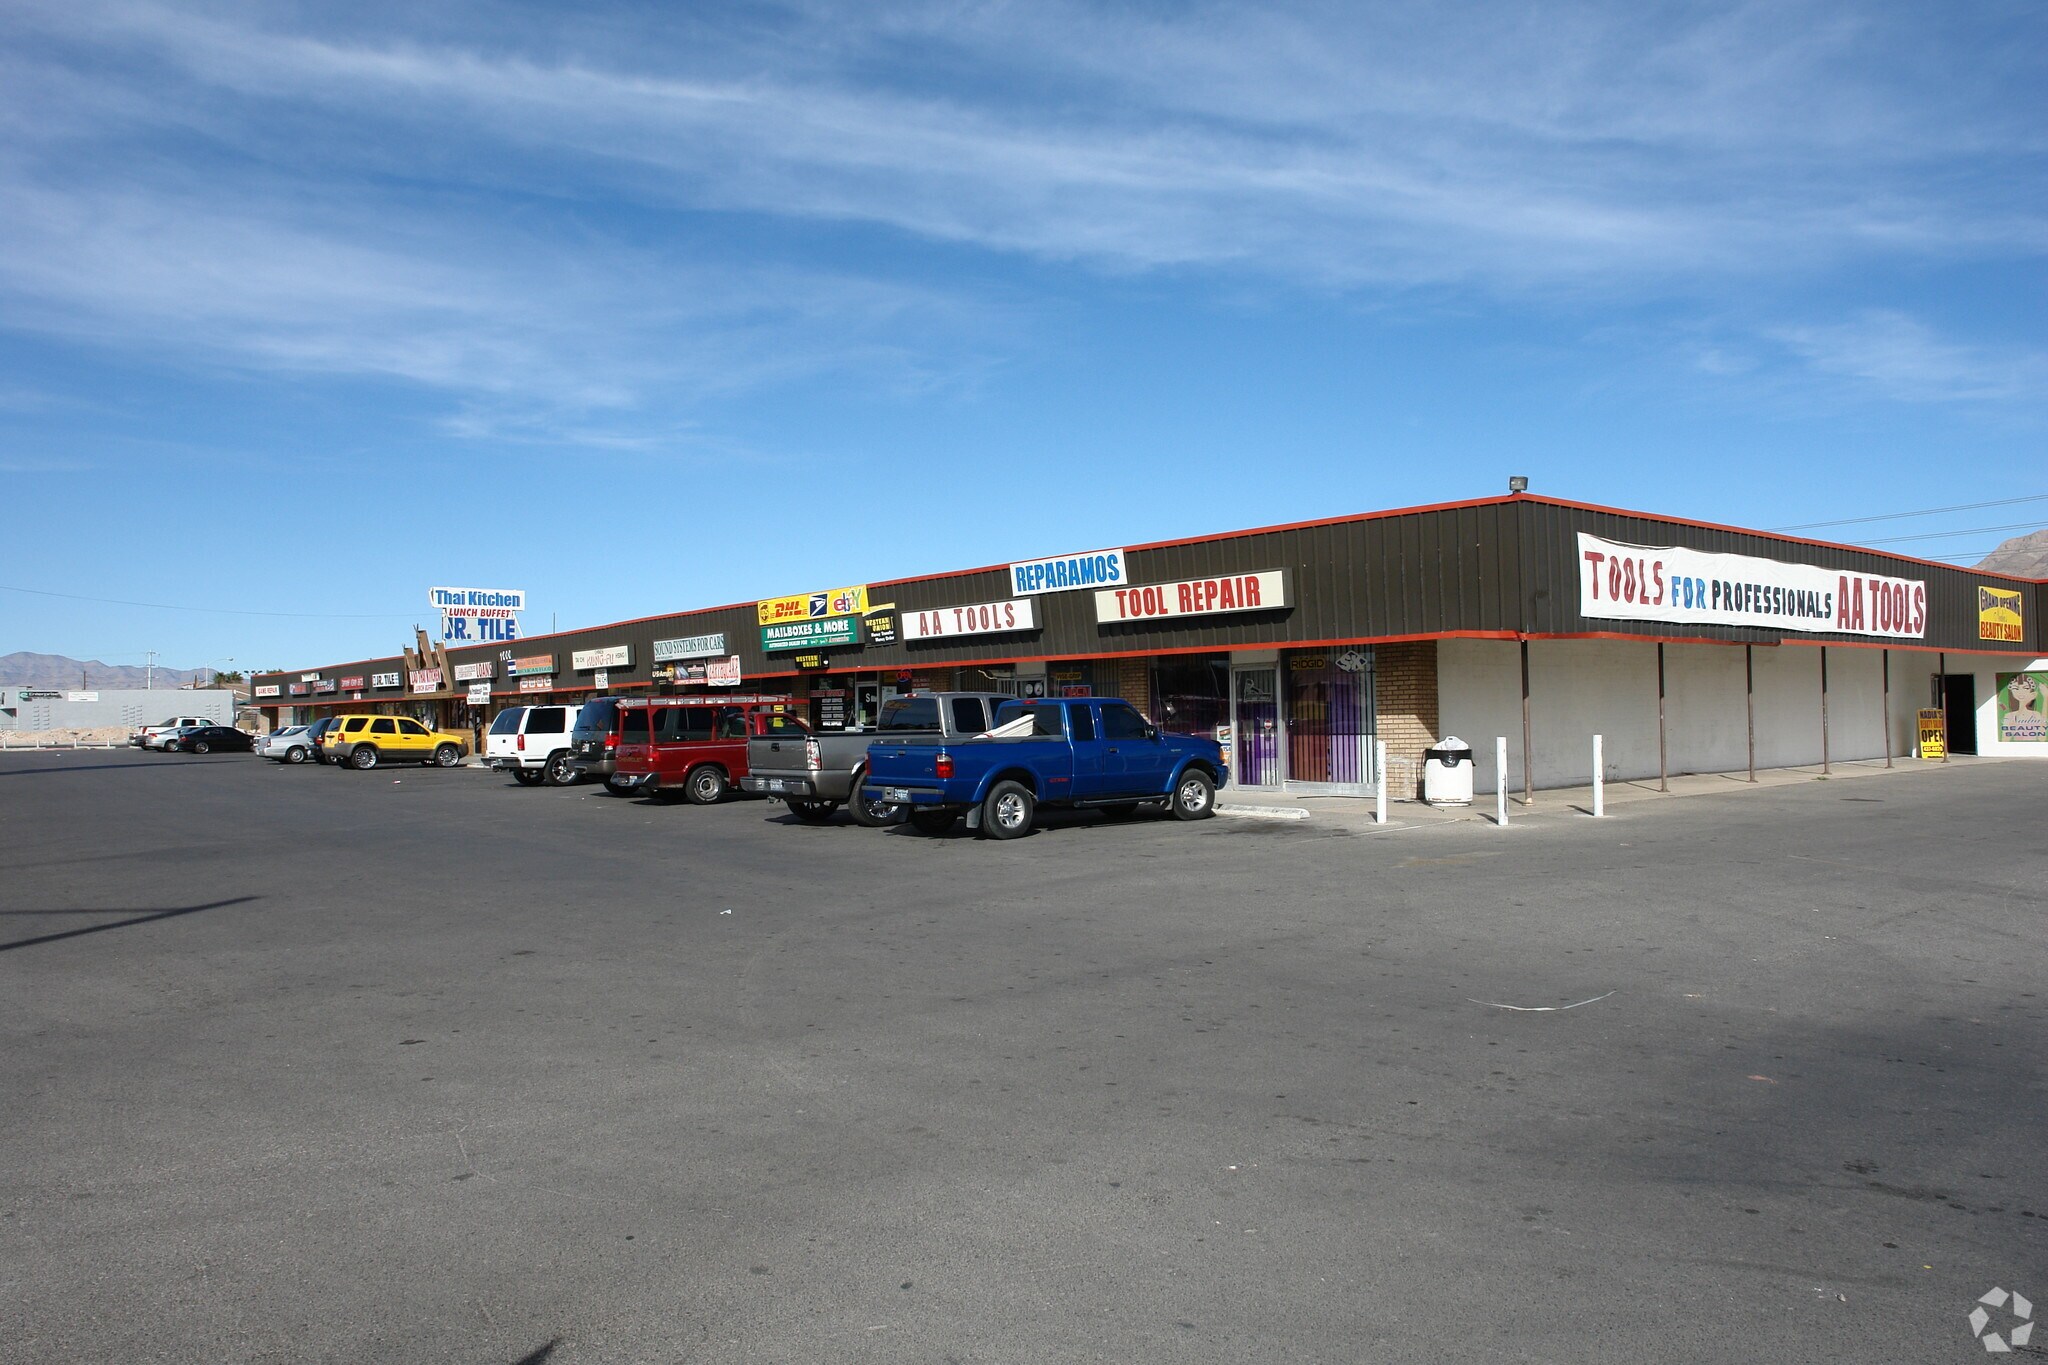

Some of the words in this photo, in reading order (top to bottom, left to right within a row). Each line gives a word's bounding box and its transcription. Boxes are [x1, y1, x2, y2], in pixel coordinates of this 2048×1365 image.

[1015, 555, 1120, 592] REPARAMOS
[435, 590, 465, 605] Thai
[468, 591, 520, 607] Kitchen
[1115, 586, 1168, 618] TOOL
[1177, 576, 1261, 613] REPAIR
[1584, 550, 1664, 606] TOOLS
[1671, 575, 1706, 609] FOR
[1711, 579, 1832, 619] PROFESSIONALS
[1837, 575, 1865, 630] AA
[1869, 579, 1925, 635] TOOLS
[774, 600, 803, 617] DHL
[1980, 587, 1999, 612] GRAND
[2000, 593, 2021, 617] OPENING
[449, 608, 477, 616] LUNCH
[480, 608, 511, 618] BUFFET
[865, 616, 890, 627] WESTERN
[920, 611, 943, 636] AA
[953, 602, 1015, 633] TOOLS
[444, 617, 472, 640] JR.
[477, 619, 515, 640] TILE
[766, 625, 813, 639] MAILBOXES
[814, 623, 822, 633] &
[823, 619, 849, 633] MORE
[872, 624, 892, 632] UNION
[1980, 621, 2003, 640] BEAUTY
[2004, 623, 2021, 640] SALON
[654, 641, 673, 656] SOUND
[673, 638, 697, 654] SYSTEMS
[697, 637, 709, 651] FOR
[709, 635, 725, 650] CARS
[476, 662, 492, 678] LOANS
[1291, 659, 1325, 669] RIDGID
[385, 674, 395, 685] TILE
[1920, 711, 1943, 719] NADIA'S
